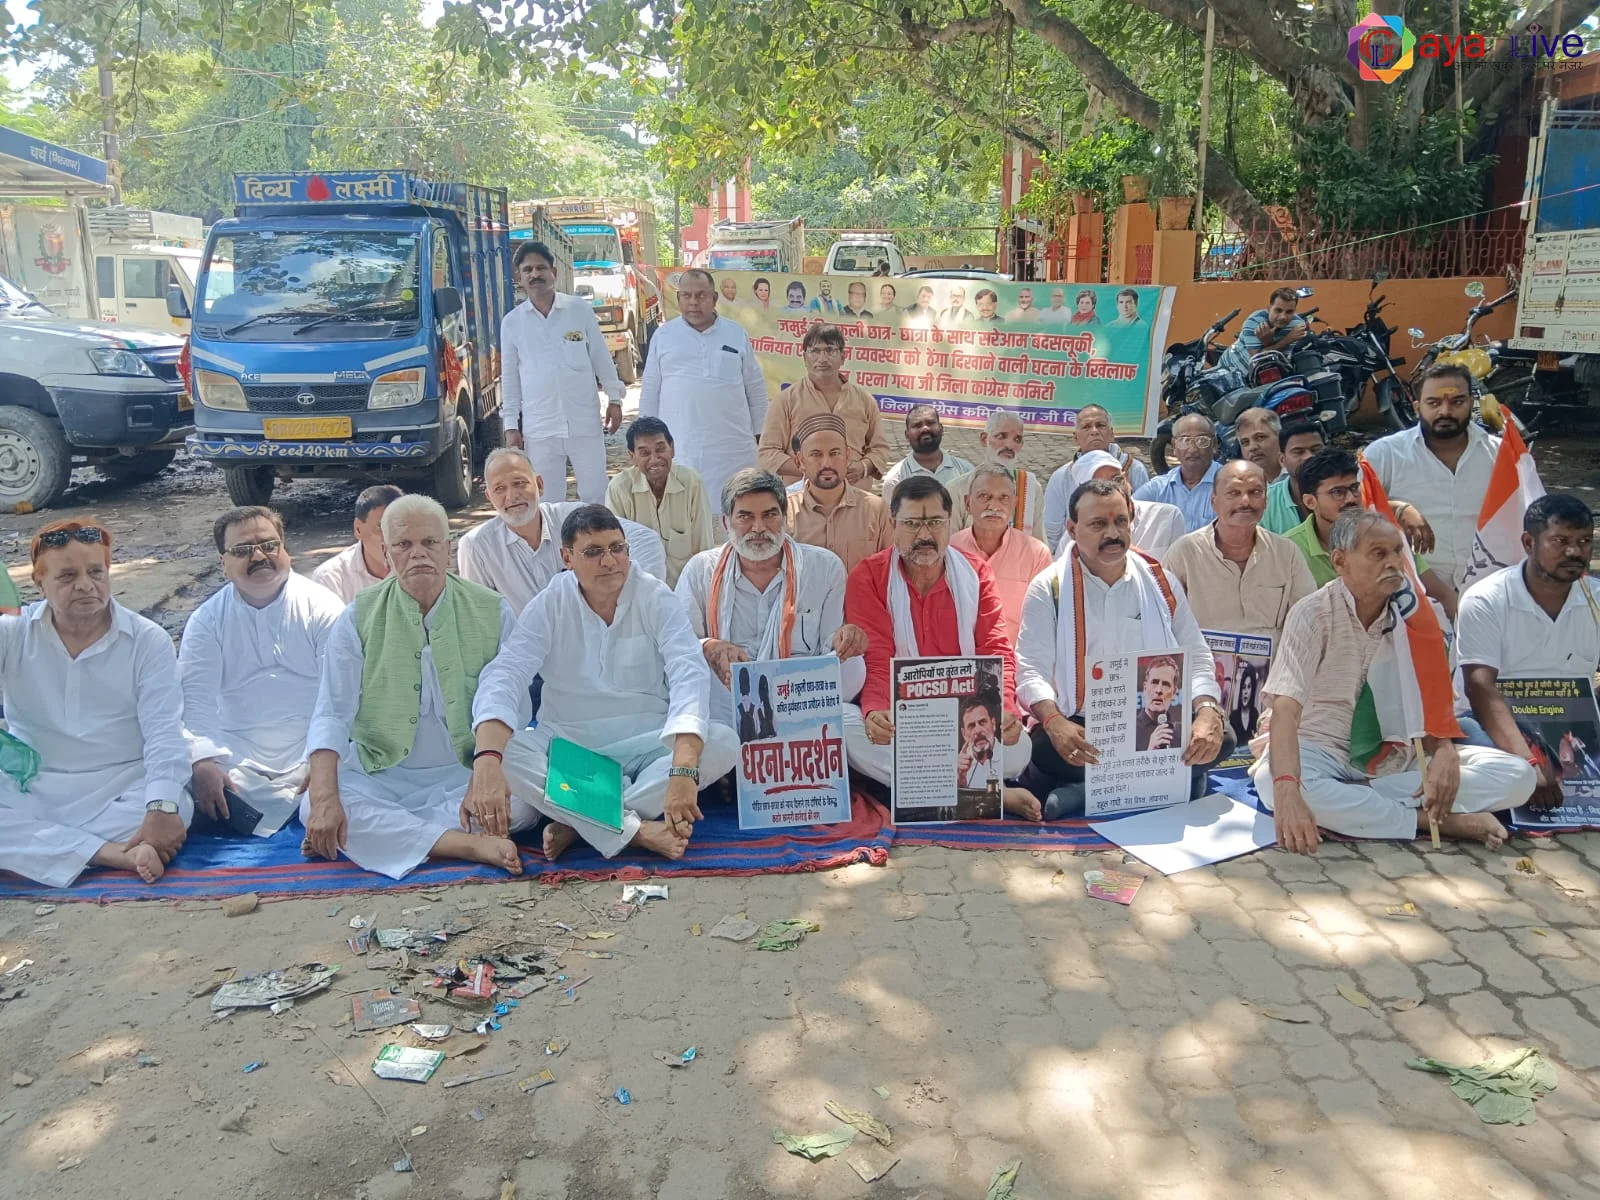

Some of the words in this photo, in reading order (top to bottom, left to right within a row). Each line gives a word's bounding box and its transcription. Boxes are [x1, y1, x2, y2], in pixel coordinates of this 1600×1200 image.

[30, 145, 47, 162] चर्च
[242, 177, 299, 201] दिव्य
[331, 174, 396, 199] लक्ष्मी
[777, 317, 807, 338] जमुई
[834, 320, 864, 341] कूली
[899, 327, 928, 342] छात्रा
[931, 324, 944, 343] के
[947, 329, 976, 345] साथ
[978, 328, 1030, 349] सरेआम
[1031, 332, 1097, 357] बदसलूकी,
[856, 347, 901, 365] व्यवस्था
[903, 347, 922, 366] को
[926, 348, 949, 369] ठेंगा
[951, 350, 995, 372] दिखाने
[998, 354, 1030, 375] वाली
[1031, 360, 1067, 378] घटना
[1069, 356, 1083, 378] के
[1085, 358, 1138, 381] खिलाफ
[241, 373, 261, 381] ACE
[334, 370, 371, 380] MEGA
[856, 371, 889, 388] धरना
[891, 373, 915, 390] गया
[918, 371, 934, 393] जी
[936, 373, 969, 394] जिला
[971, 377, 1010, 398] कांग्रेस
[1013, 379, 1056, 400] कमिटी
[880, 398, 913, 411] जिला
[931, 400, 958, 416] ांग्रेस
[1040, 409, 1060, 423] जी
[903, 665, 935, 681] आरोपियों
[936, 667, 945, 677] पर
[960, 662, 972, 675] लगे
[777, 680, 790, 699] जमुई
[906, 680, 948, 698] POCSO
[951, 679, 975, 694] Act!
[1512, 705, 1538, 714] Double
[1538, 705, 1565, 716] Engine
[741, 723, 843, 785] धरना-प्रदर्शन
